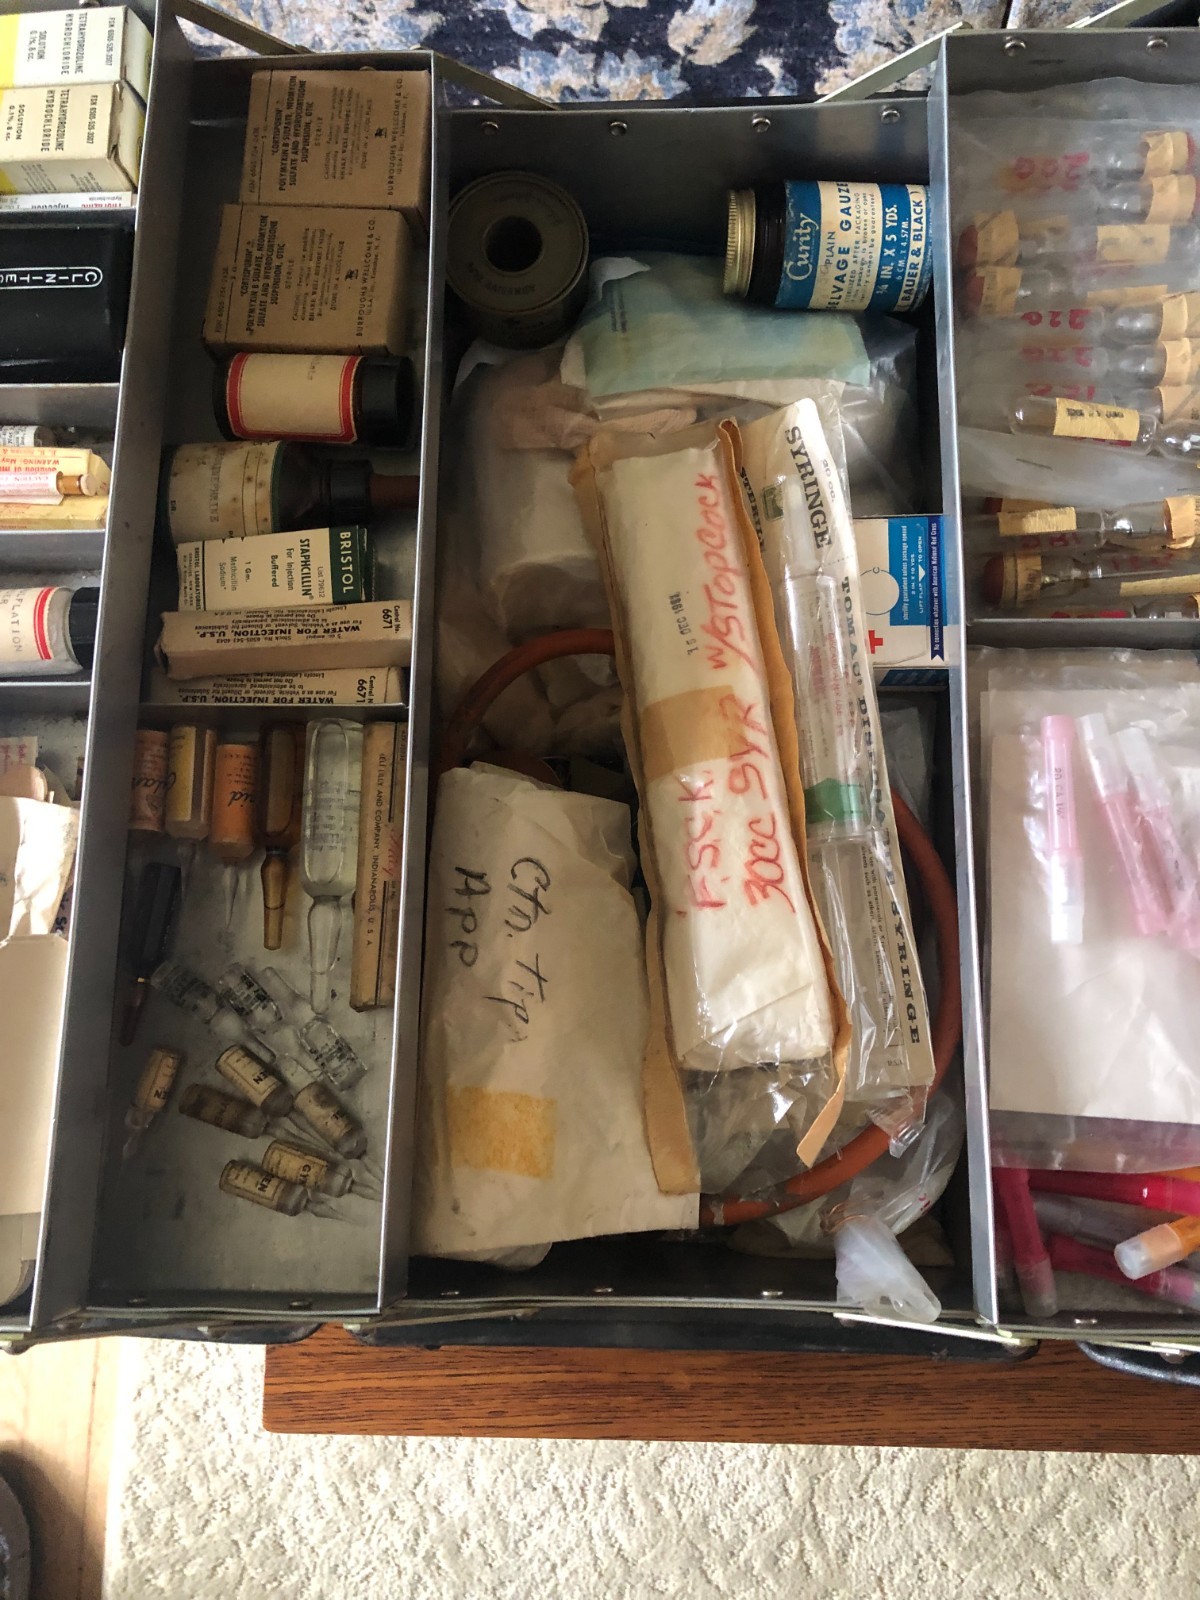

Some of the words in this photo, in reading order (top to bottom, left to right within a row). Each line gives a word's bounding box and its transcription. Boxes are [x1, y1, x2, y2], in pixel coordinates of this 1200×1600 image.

[37, 30, 47, 60] SOLUTION
[61, 13, 74, 75] HYDROCHLORIDE
[75, 12, 88, 74] TETRAHYDROZOLINE
[15, 104, 25, 140] SOLUTION
[41, 90, 56, 152] HYDROCHLORIDE
[55, 89, 70, 151] TETRAHYDROZOLINE
[293, 80, 306, 137] HYDROCORTISONE
[391, 100, 400, 142] WELLCOME
[279, 149, 288, 191] POLYMYXIN
[286, 75, 297, 109] NEOMYCIN
[314, 116, 323, 146] STERILE
[289, 158, 298, 186] SULFATE
[387, 145, 397, 196] BURROUGHS
[837, 182, 852, 231] GAUZE
[885, 204, 898, 228] YDS.
[912, 199, 923, 242] BLACK
[264, 221, 278, 280] HYDROCORTISONE
[277, 243, 285, 259] OTIC
[784, 213, 819, 280] Curity
[824, 231, 836, 265] PLAIN
[852, 240, 860, 264] AFTER
[868, 238, 875, 248] be
[883, 248, 896, 257] X
[885, 234, 897, 242] 5
[910, 247, 921, 257] &
[0, 272, 98, 282] CLINITE
[245, 290, 258, 332] POLYMYXIN
[256, 216, 268, 251] NEOMYCIN
[285, 260, 294, 289] STERILE
[360, 241, 373, 283] WELLCOME
[880, 262, 894, 279] IN.
[261, 282, 269, 297] AND
[901, 262, 919, 301] BAUER
[257, 301, 268, 327] SULFATE
[355, 286, 367, 336] BURROUGHS
[785, 426, 832, 549] SYRINGE
[286, 548, 294, 560] For
[340, 531, 354, 594] BRISTOL
[918, 554, 922, 562] TO
[230, 556, 238, 591] Methicillin
[271, 555, 279, 587] Buffered
[286, 562, 294, 591] Injection
[231, 629, 291, 637] INJECTION,
[323, 625, 360, 633] WATER
[382, 609, 393, 629] 6671
[677, 617, 691, 635] DEC
[180, 695, 207, 703] U.S.P.
[356, 679, 367, 703] 6671
[719, 694, 768, 800] SYR
[377, 770, 385, 786] LILLY
[372, 810, 382, 852] COMPANY,
[890, 901, 920, 1043] SYRINGE
